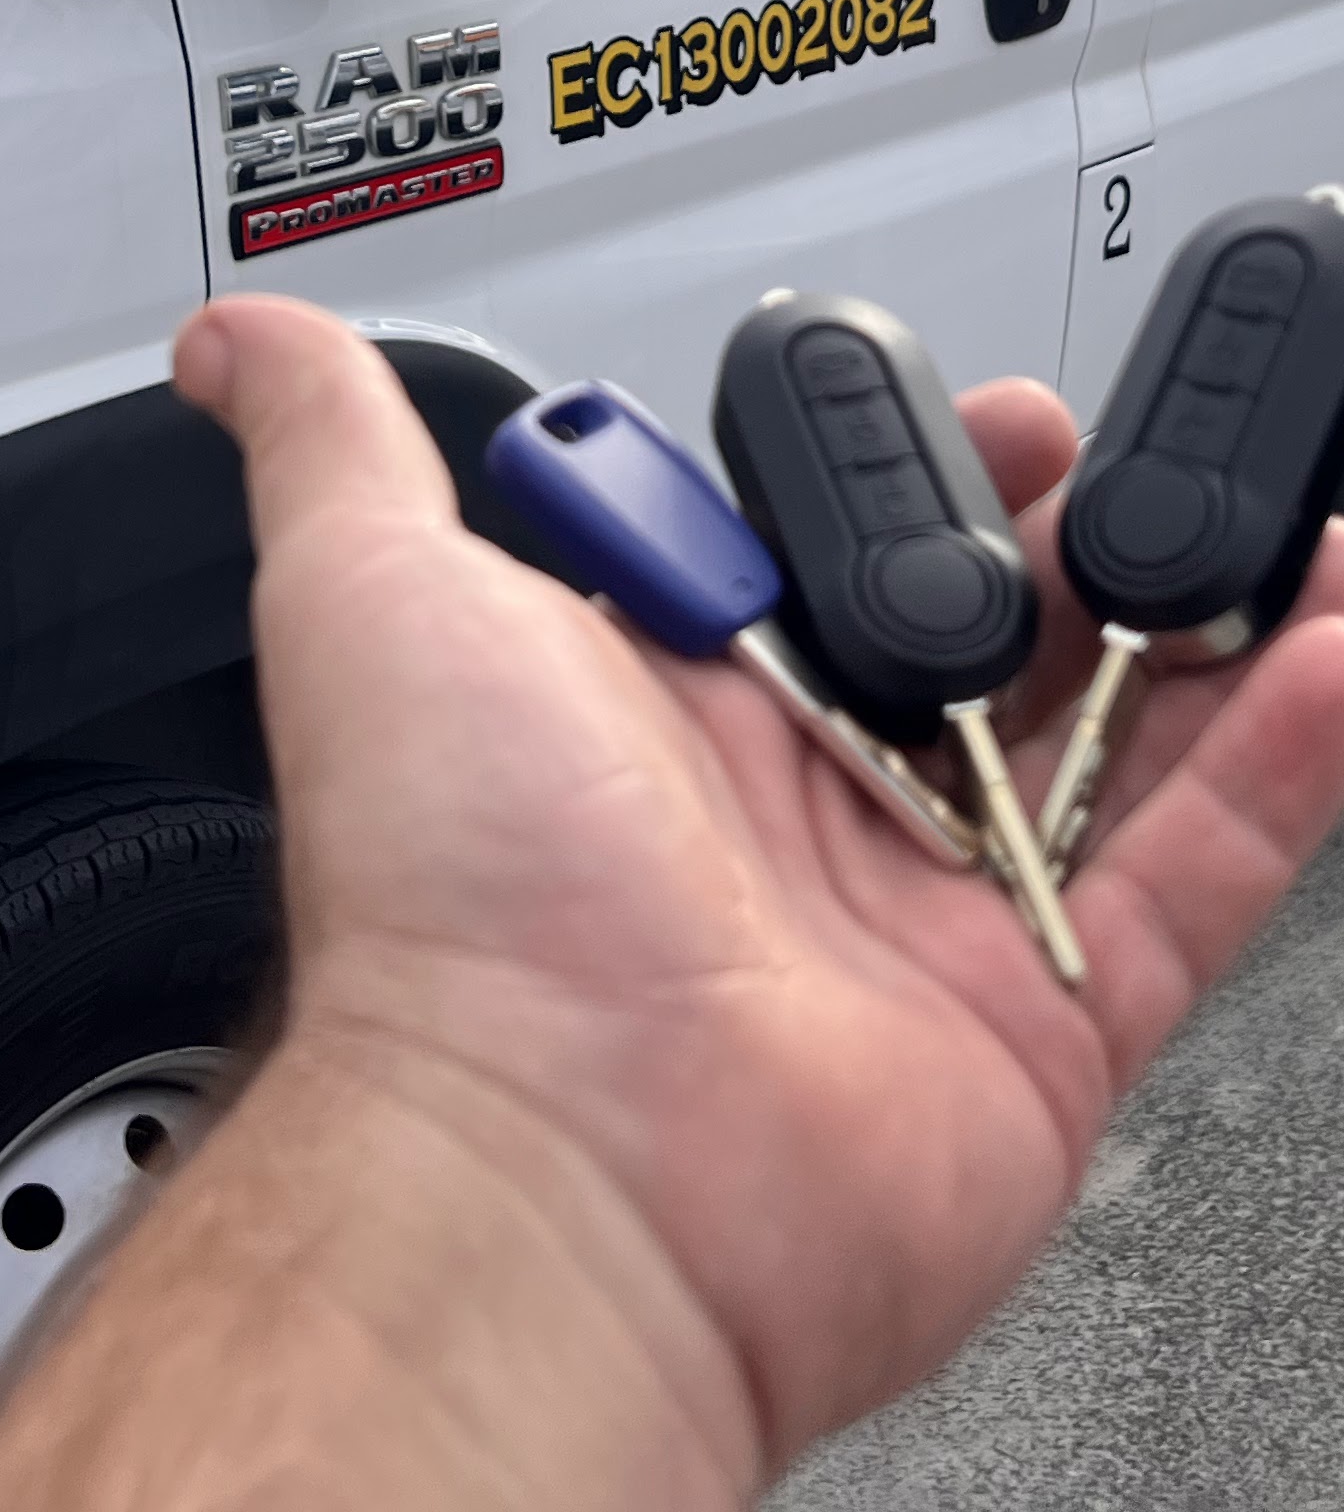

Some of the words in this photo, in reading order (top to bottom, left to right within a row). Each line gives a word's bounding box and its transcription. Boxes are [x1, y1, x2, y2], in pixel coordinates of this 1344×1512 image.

[217, 19, 502, 133] RAM
[224, 80, 504, 196] 2500
[1103, 173, 1131, 261] 2
